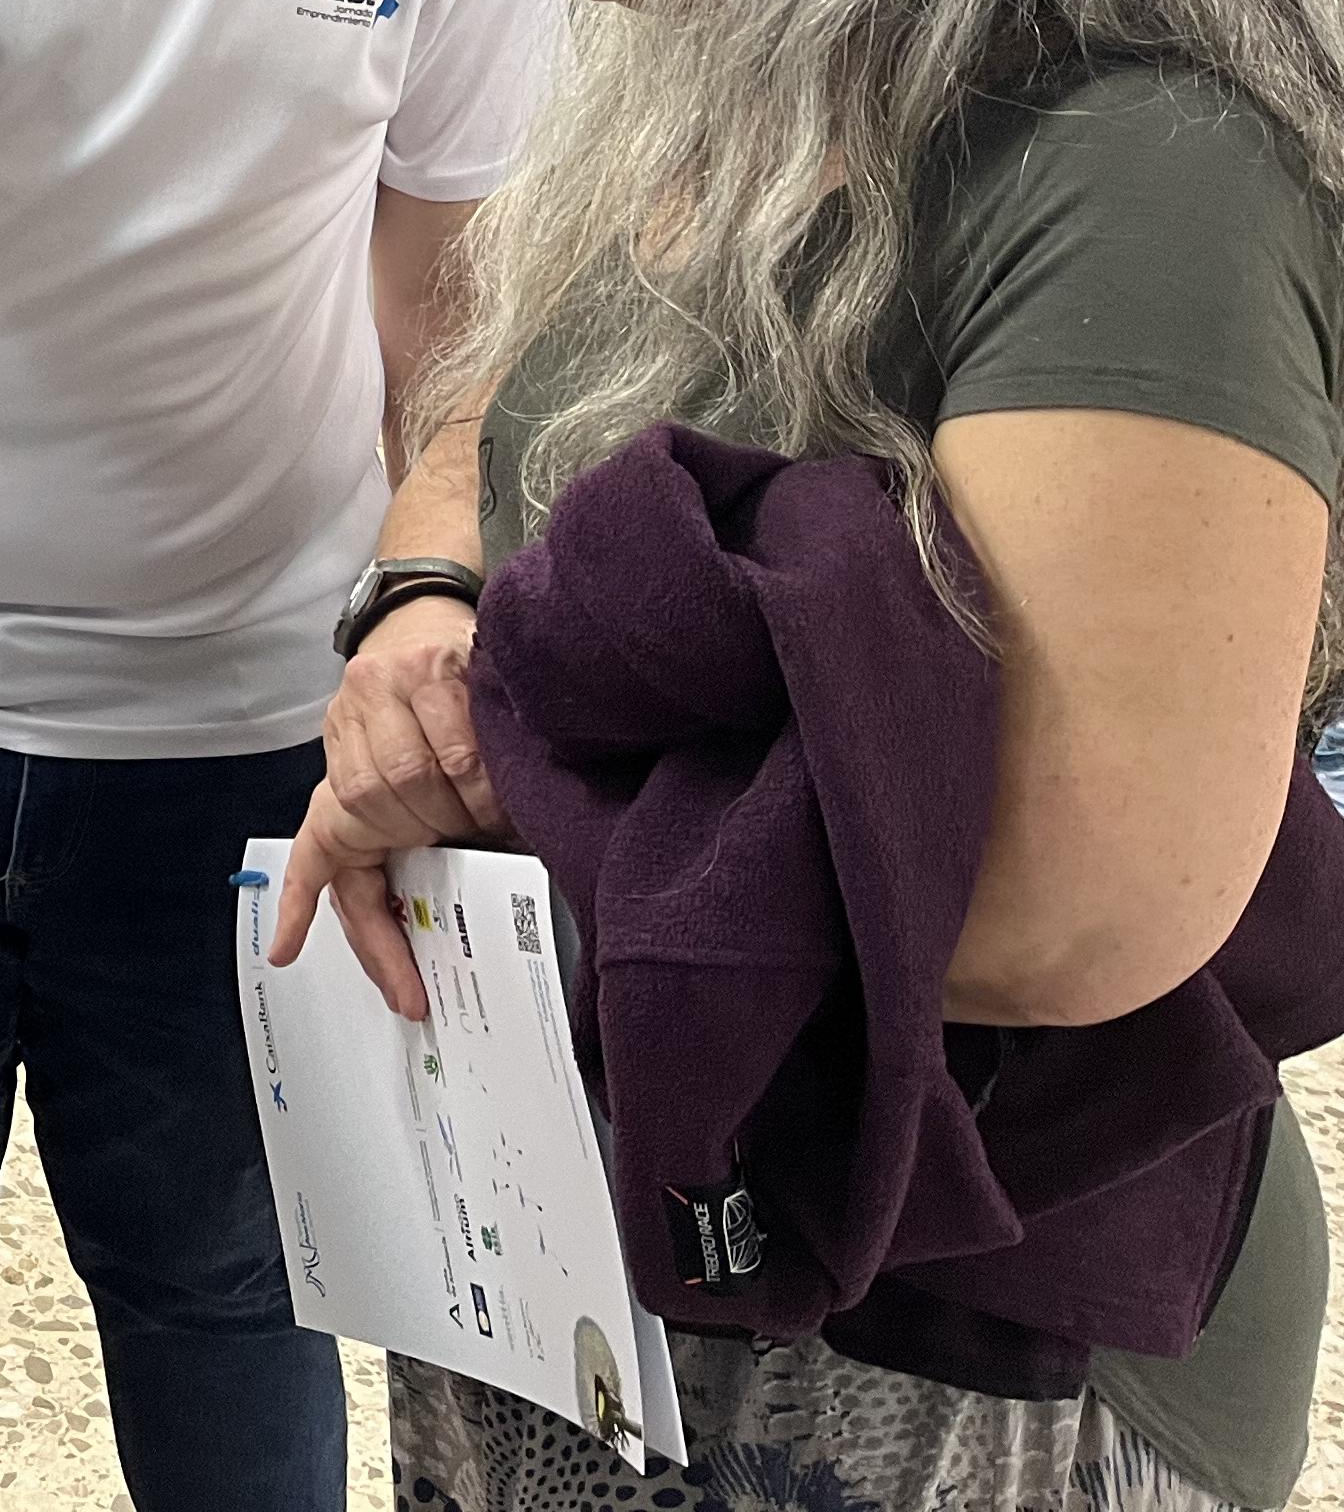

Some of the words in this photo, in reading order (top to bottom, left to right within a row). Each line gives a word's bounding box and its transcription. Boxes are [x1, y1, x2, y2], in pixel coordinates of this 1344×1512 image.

[296, 6, 372, 29] Emprendimiento
[334, 5, 374, 19] Jornada
[254, 981, 278, 1074] CaixaBank
[693, 1202, 714, 1236] RACE
